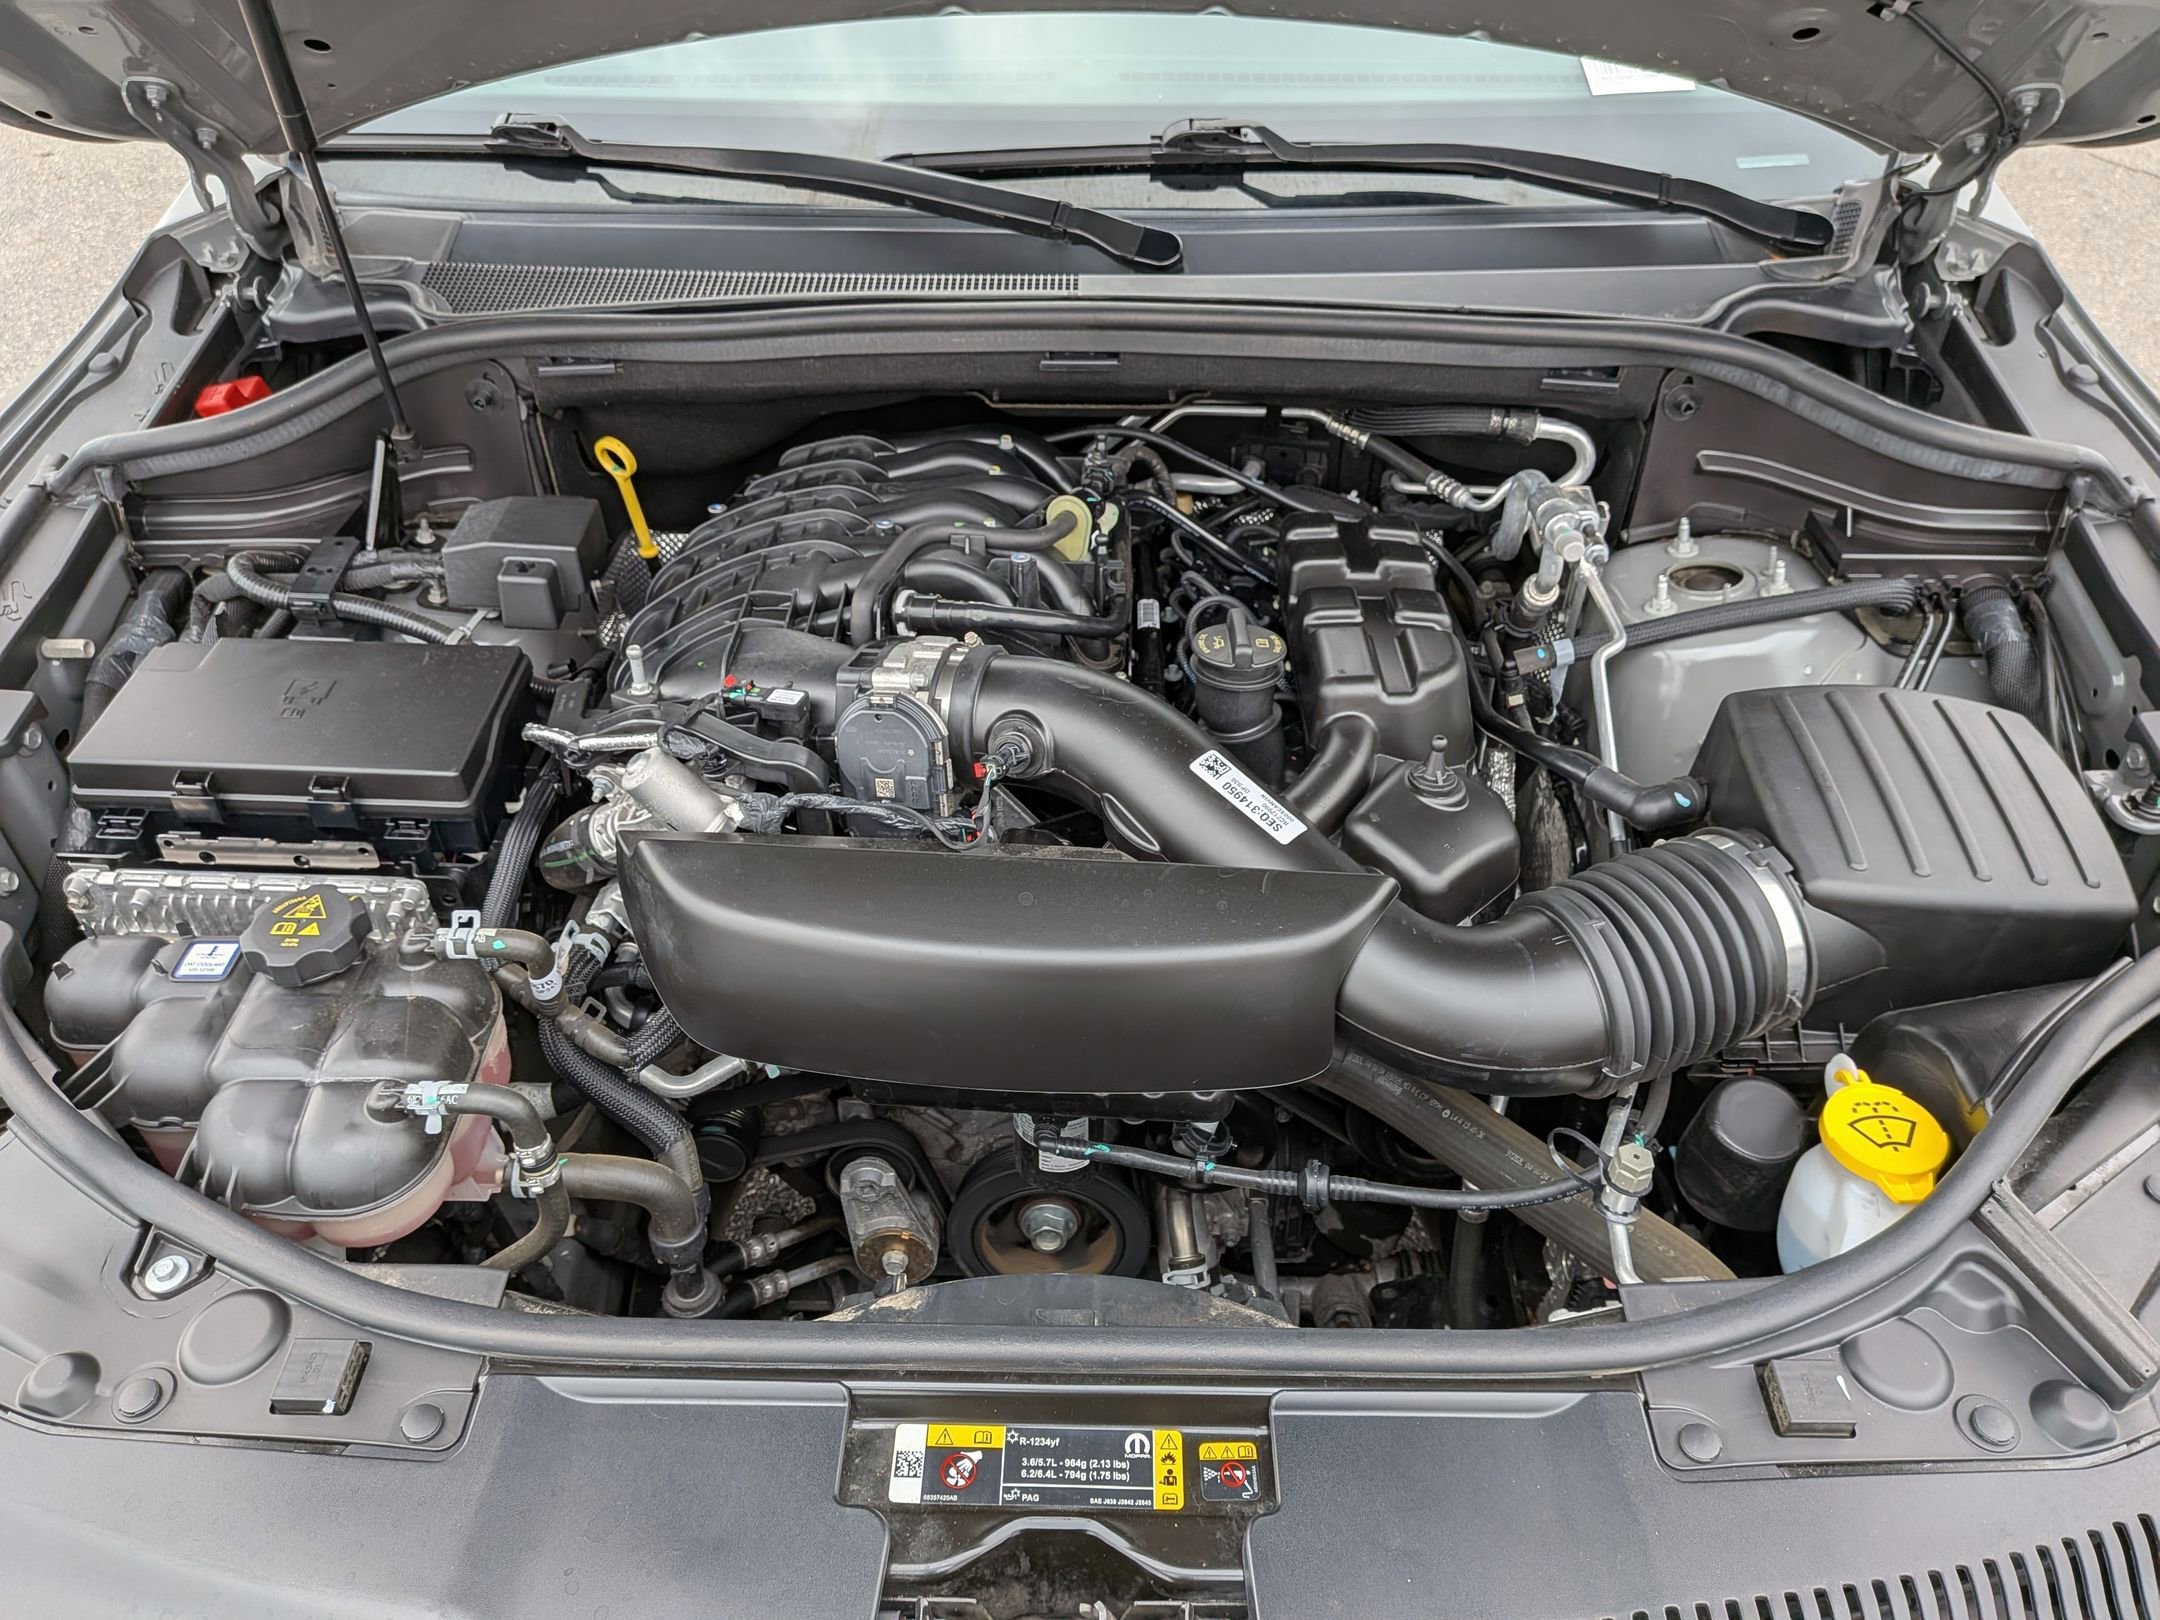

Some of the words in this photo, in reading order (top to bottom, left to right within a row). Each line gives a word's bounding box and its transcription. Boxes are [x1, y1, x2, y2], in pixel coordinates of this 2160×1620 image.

[1222, 781, 1283, 832] SEQ:314950
[1019, 1436, 1060, 1449] R-1234yf
[1021, 1457, 1058, 1467] 3.6/5.7L
[1064, 1458, 1087, 1470] 964g
[1089, 1459, 1111, 1470] (2.13
[1113, 1459, 1130, 1471] lbs)
[1020, 1469, 1058, 1479] 6.2/6.4L
[1064, 1470, 1087, 1482] 794g
[1089, 1471, 1111, 1482] (1.75
[1113, 1471, 1130, 1483] lbs)
[1021, 1493, 1040, 1502] PAG
